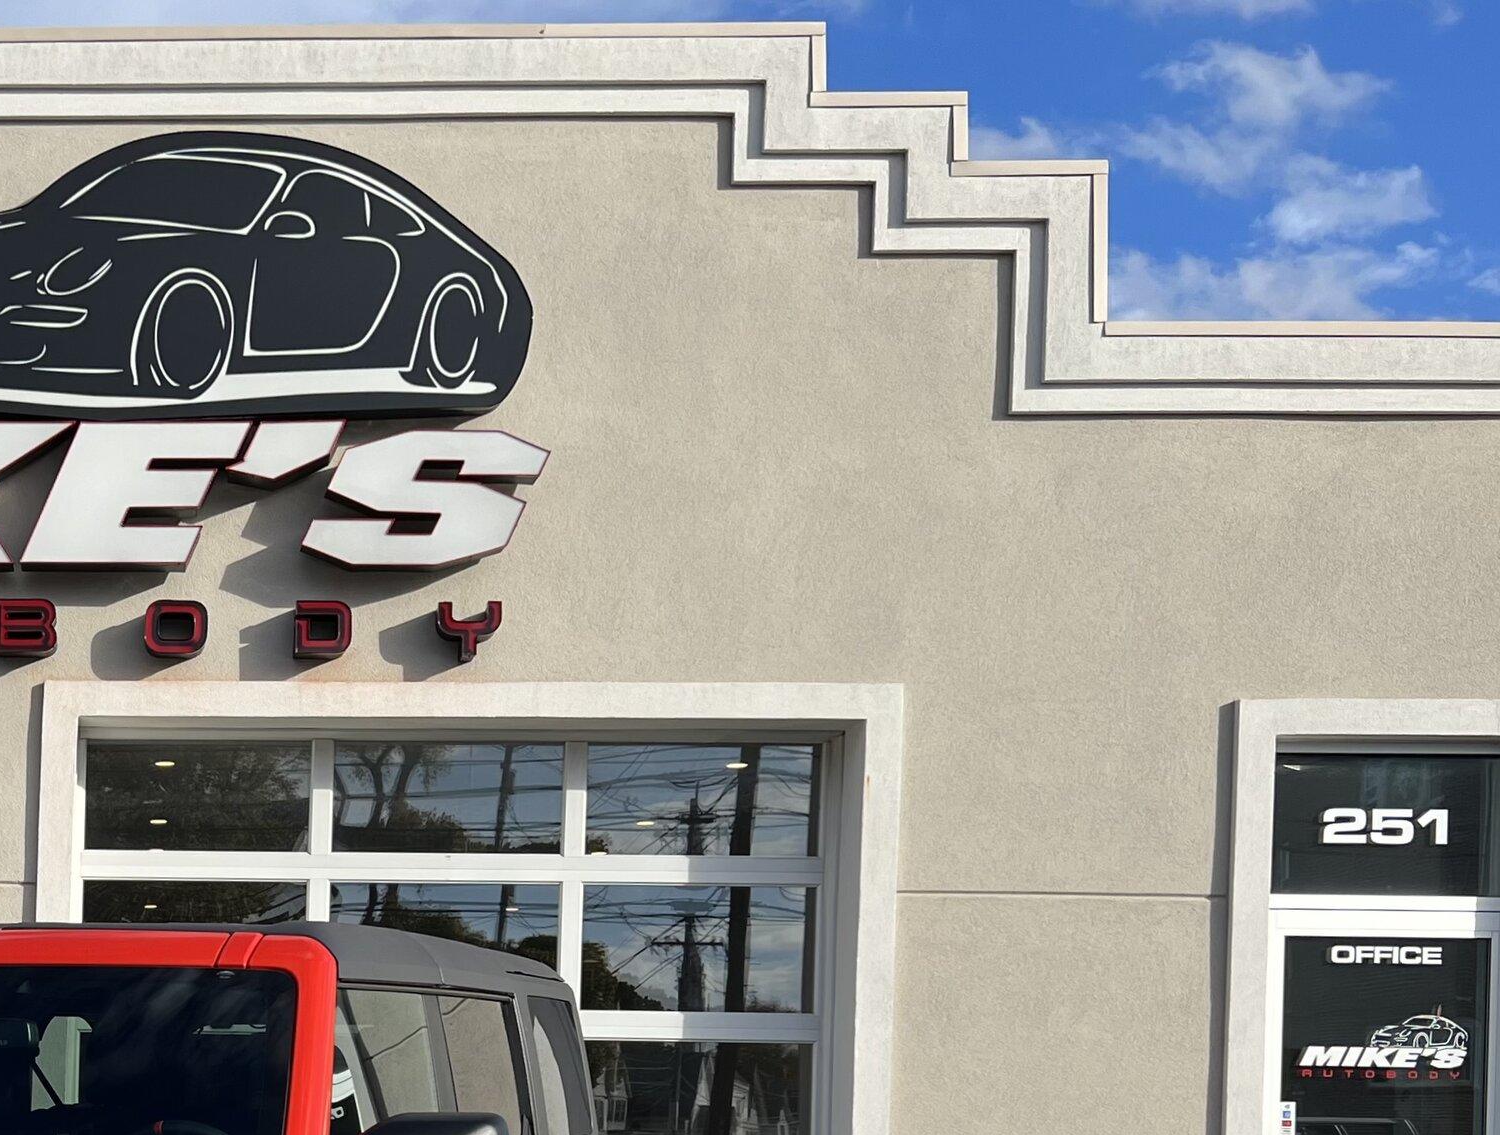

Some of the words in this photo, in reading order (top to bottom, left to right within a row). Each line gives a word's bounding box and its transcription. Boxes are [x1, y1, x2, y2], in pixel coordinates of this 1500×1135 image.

[1321, 807, 1449, 845] 251
[1330, 945, 1443, 965] OFFICE
[1299, 1045, 1468, 1069] MIKE'S
[1301, 1068, 1461, 1080] AUTOBODY
